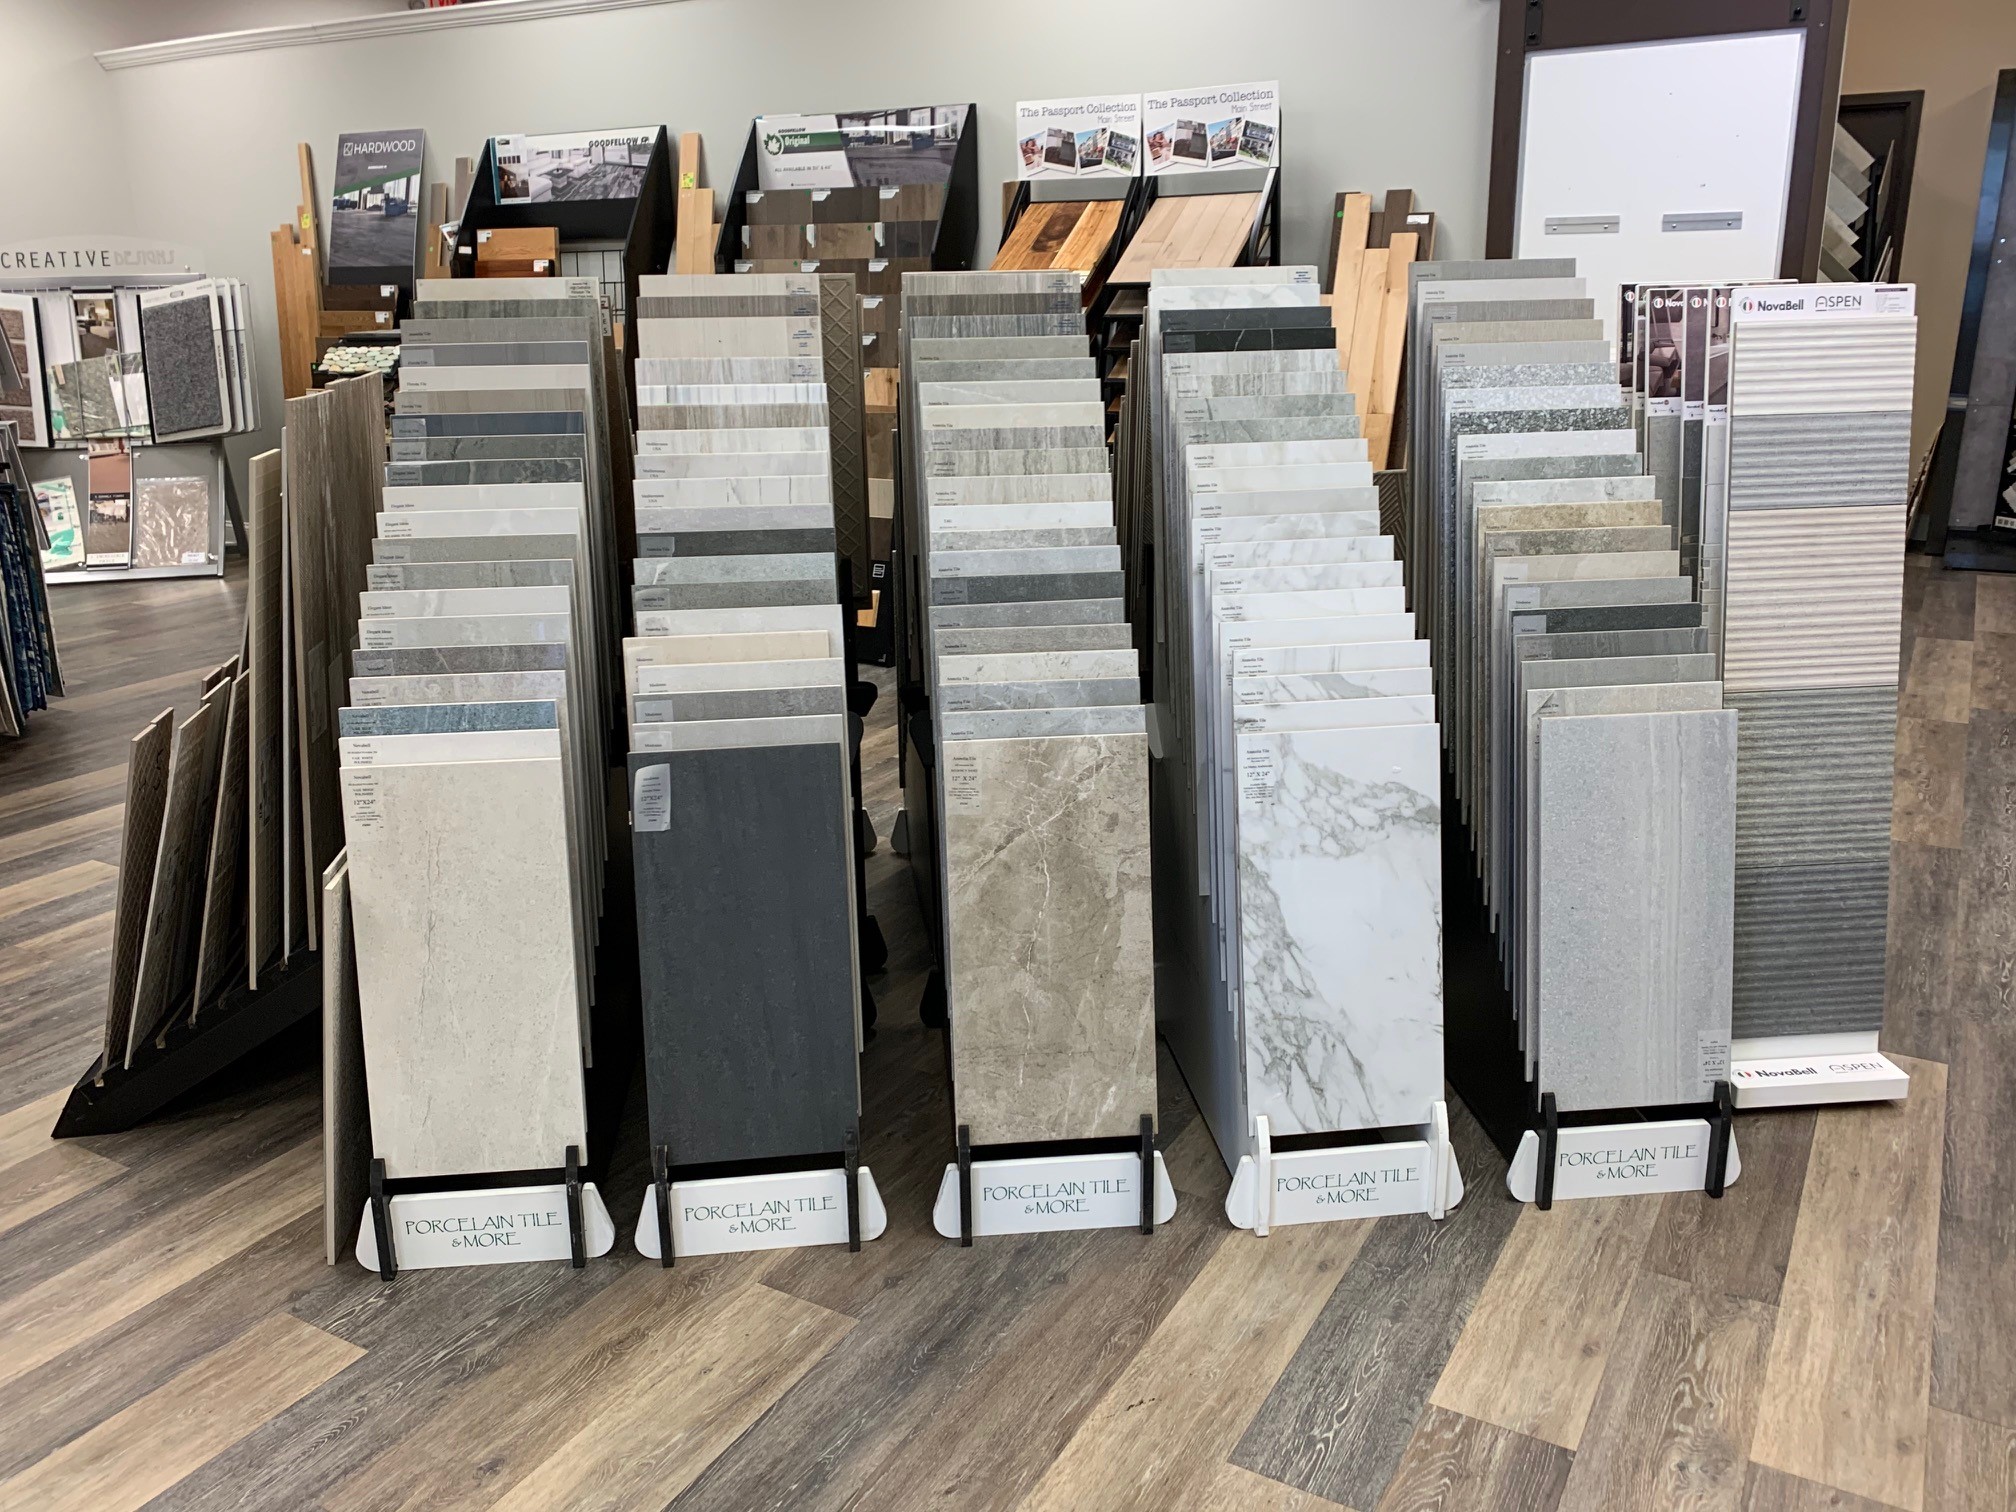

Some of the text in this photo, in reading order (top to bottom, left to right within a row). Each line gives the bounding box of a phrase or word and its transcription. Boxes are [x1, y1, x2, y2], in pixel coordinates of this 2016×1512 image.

[1148, 88, 1274, 110] The Passport Collection
[1020, 102, 1136, 118] The Passport Collection
[1231, 102, 1272, 113] Main Street
[1114, 114, 1135, 122] Street
[354, 140, 416, 154] HARDWOOD
[588, 136, 638, 147] GOODFELLOW
[785, 135, 810, 147] Original
[0, 250, 111, 268] CREATIVE
[1757, 299, 1804, 312] NovaBell
[1815, 296, 1862, 308] ASPEN
[1756, 1062, 1883, 1078] NovaBell ASPEN
[1559, 1143, 1698, 1167] PORCELAIN TILE
[1596, 1164, 1658, 1179] & MORE
[1276, 1168, 1419, 1192] PORCELAIN TILE
[983, 1178, 1130, 1201] PORCELAIN TILE
[1316, 1188, 1380, 1204] & MORE
[684, 1196, 837, 1222] PORCELAIN TILE
[1024, 1198, 1090, 1214] & MORE
[406, 1211, 562, 1235] PORCELAIN TILE
[729, 1217, 796, 1234] & MORE
[451, 1232, 521, 1247] & MORE
